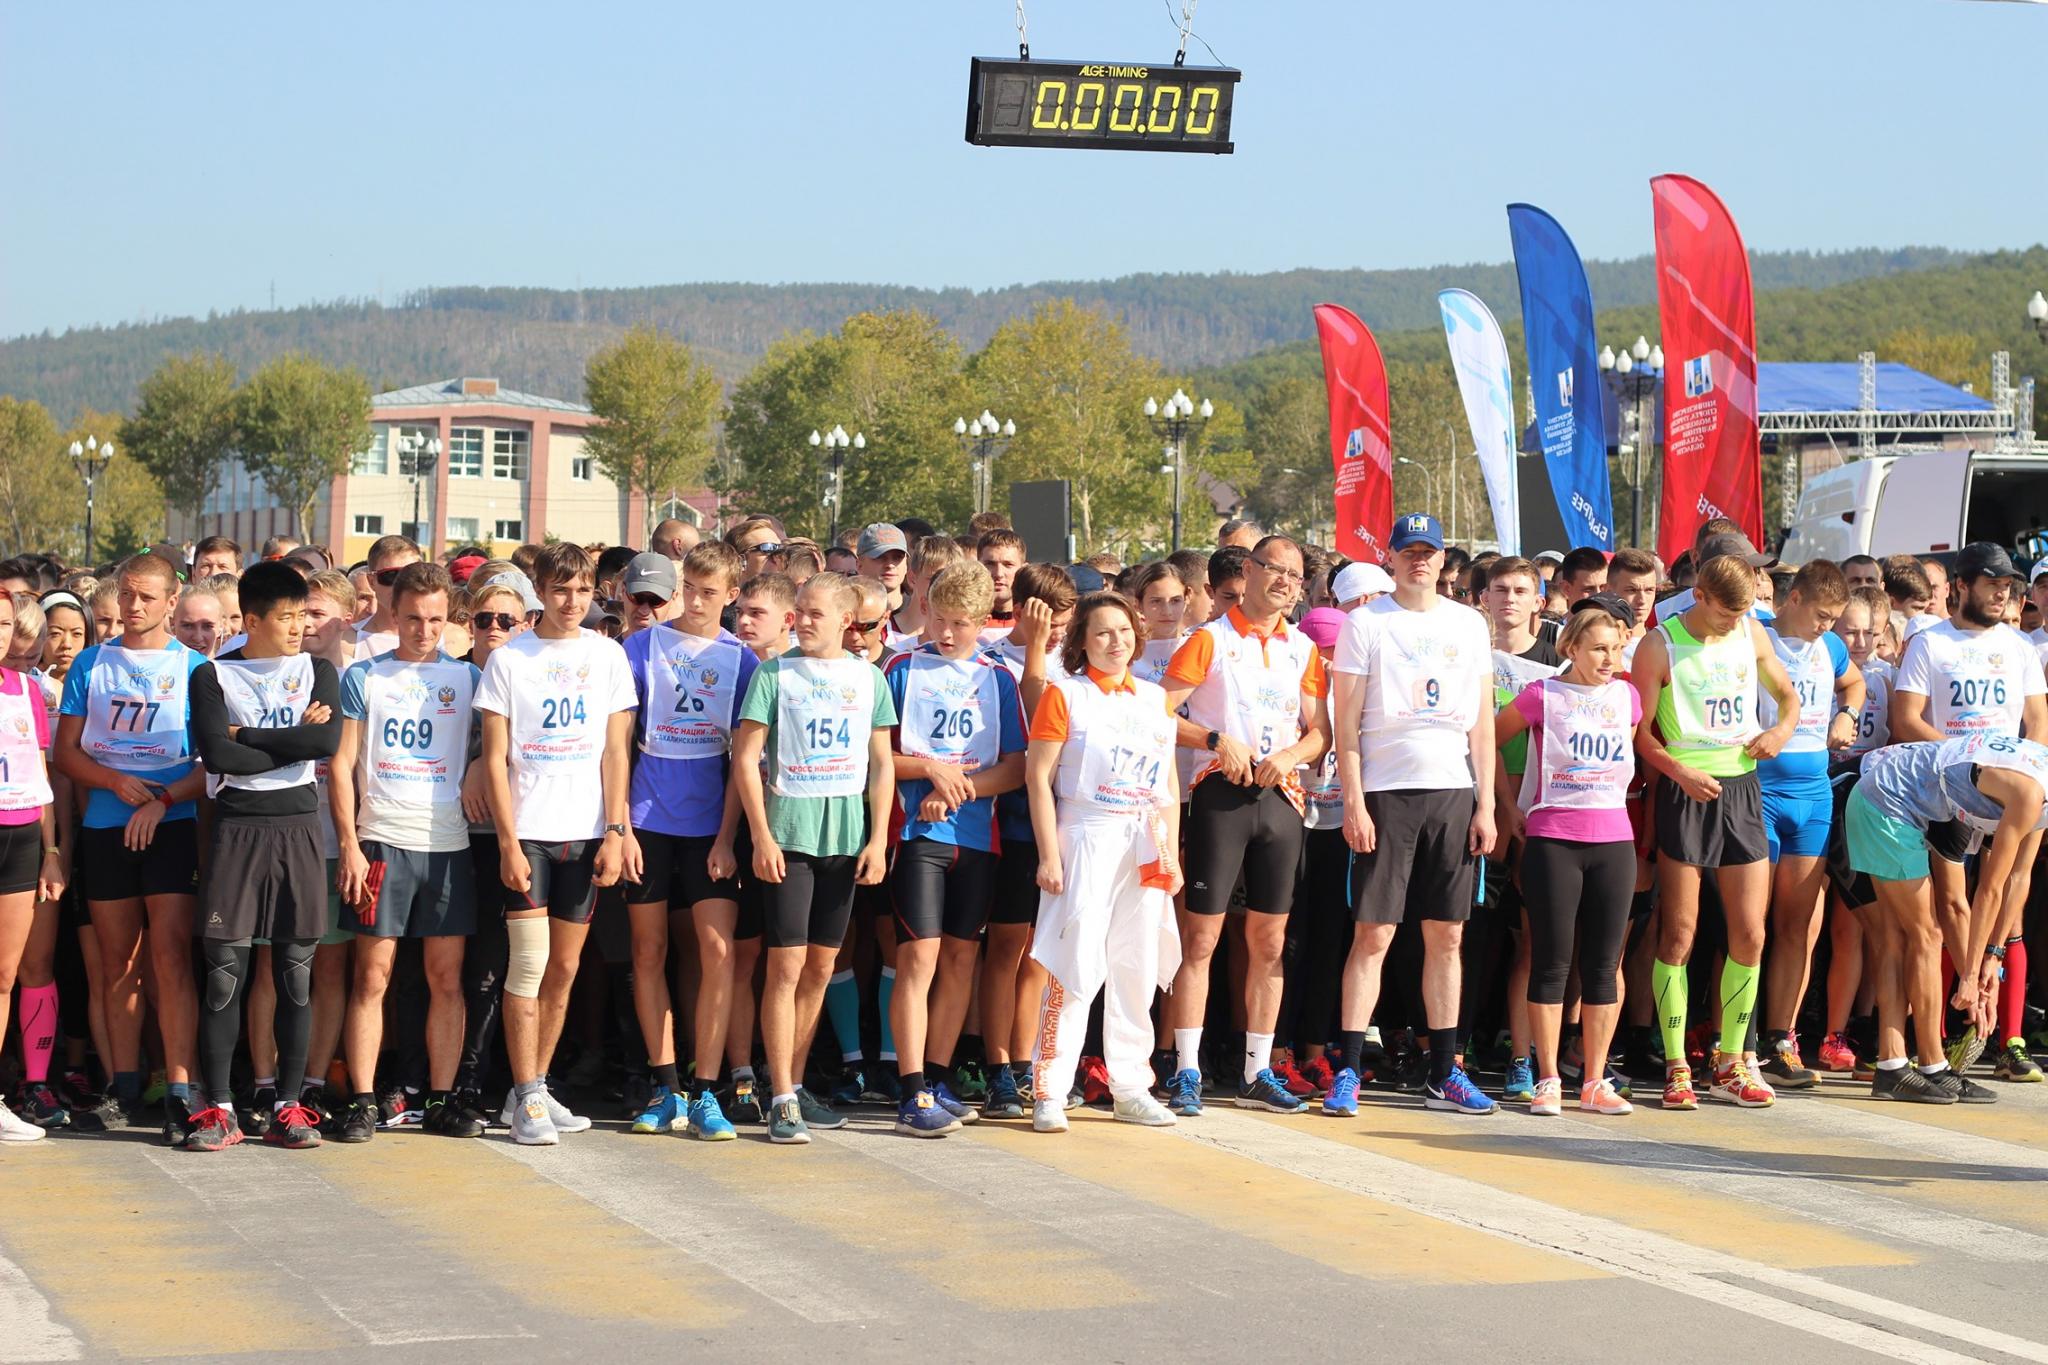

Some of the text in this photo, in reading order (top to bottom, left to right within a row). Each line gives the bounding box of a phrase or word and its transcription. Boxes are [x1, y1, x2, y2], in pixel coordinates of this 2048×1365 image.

[1078, 65, 1148, 78] ALGE-TIMING
[1032, 81, 1219, 134] 0.00.00
[1426, 678, 1440, 707] 9
[1949, 678, 2006, 707] 2076
[111, 700, 160, 732] 777
[542, 694, 587, 729] 204
[1705, 695, 1744, 728] 799
[383, 717, 433, 750] 669
[656, 724, 679, 734] КРОСС
[680, 727, 706, 736] НАЦИИ
[806, 718, 850, 749] 154
[1259, 725, 1273, 755] 5
[523, 743, 547, 752] КРОСС
[1568, 731, 1624, 761] 1002
[378, 762, 402, 771] КРОСС
[1109, 745, 1160, 789] 1744
[1552, 773, 1574, 782] КРОСС
[1097, 785, 1120, 796] КРОСС
